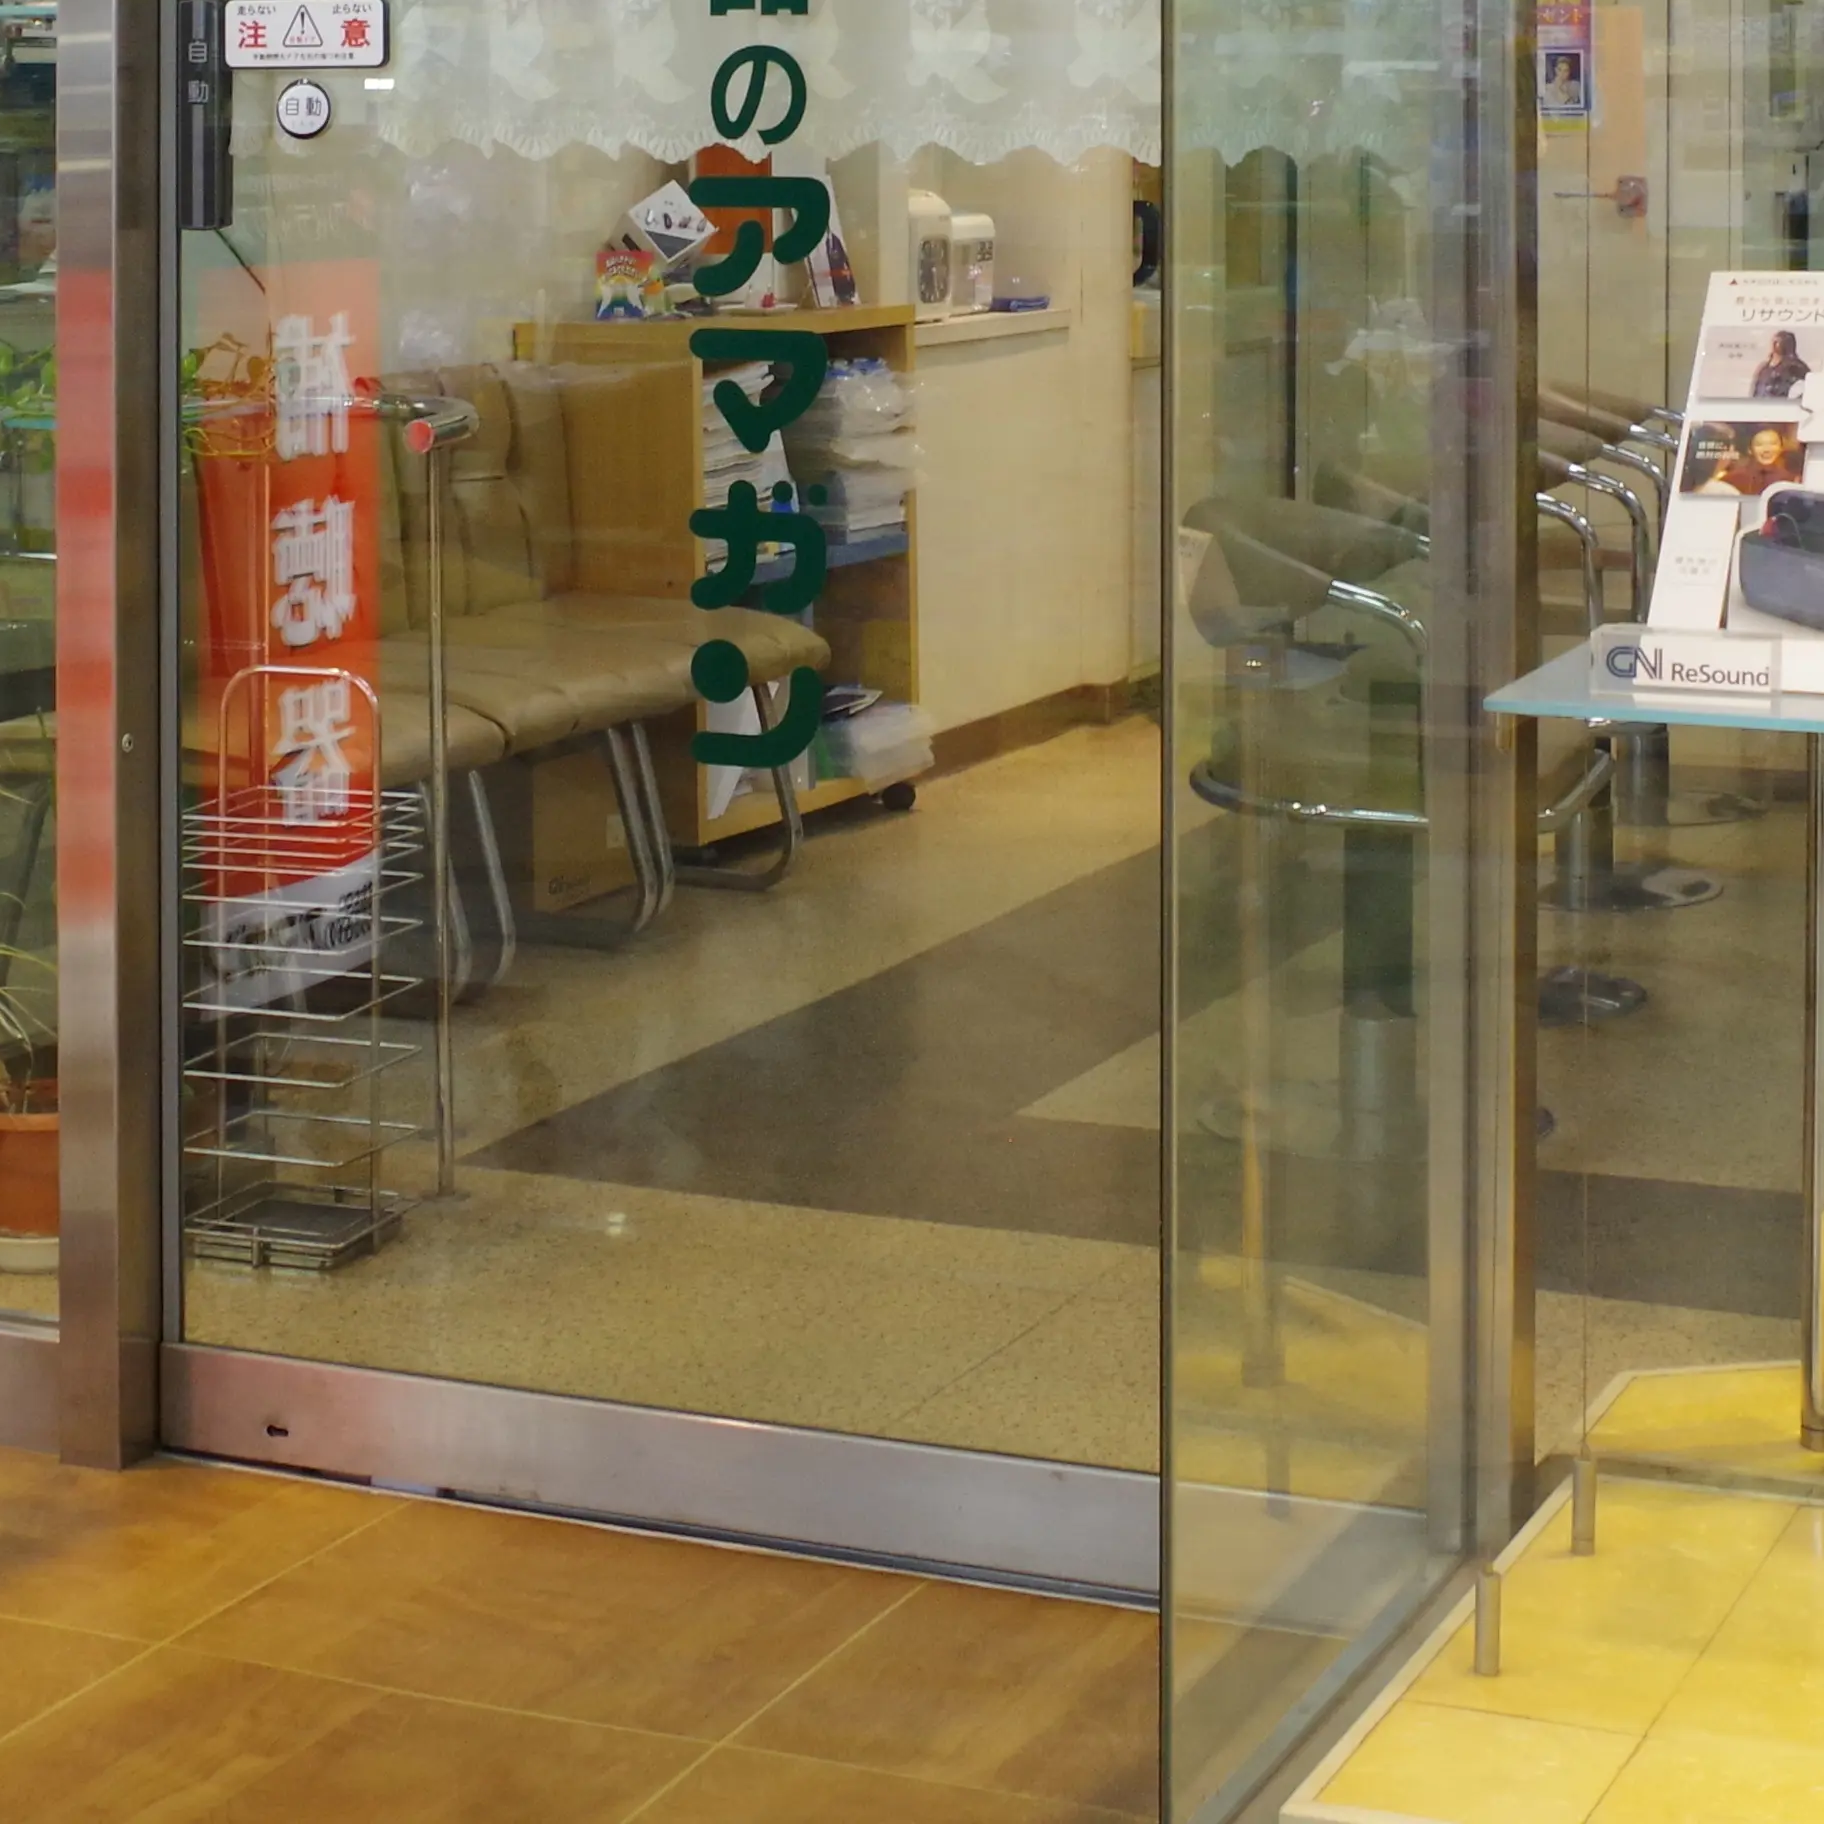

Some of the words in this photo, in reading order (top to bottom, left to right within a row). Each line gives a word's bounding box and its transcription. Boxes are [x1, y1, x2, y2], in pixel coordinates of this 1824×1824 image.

[187, 40, 209, 103] 自動
[286, 97, 322, 116] 自動
[1671, 663, 1769, 687] ReSound
